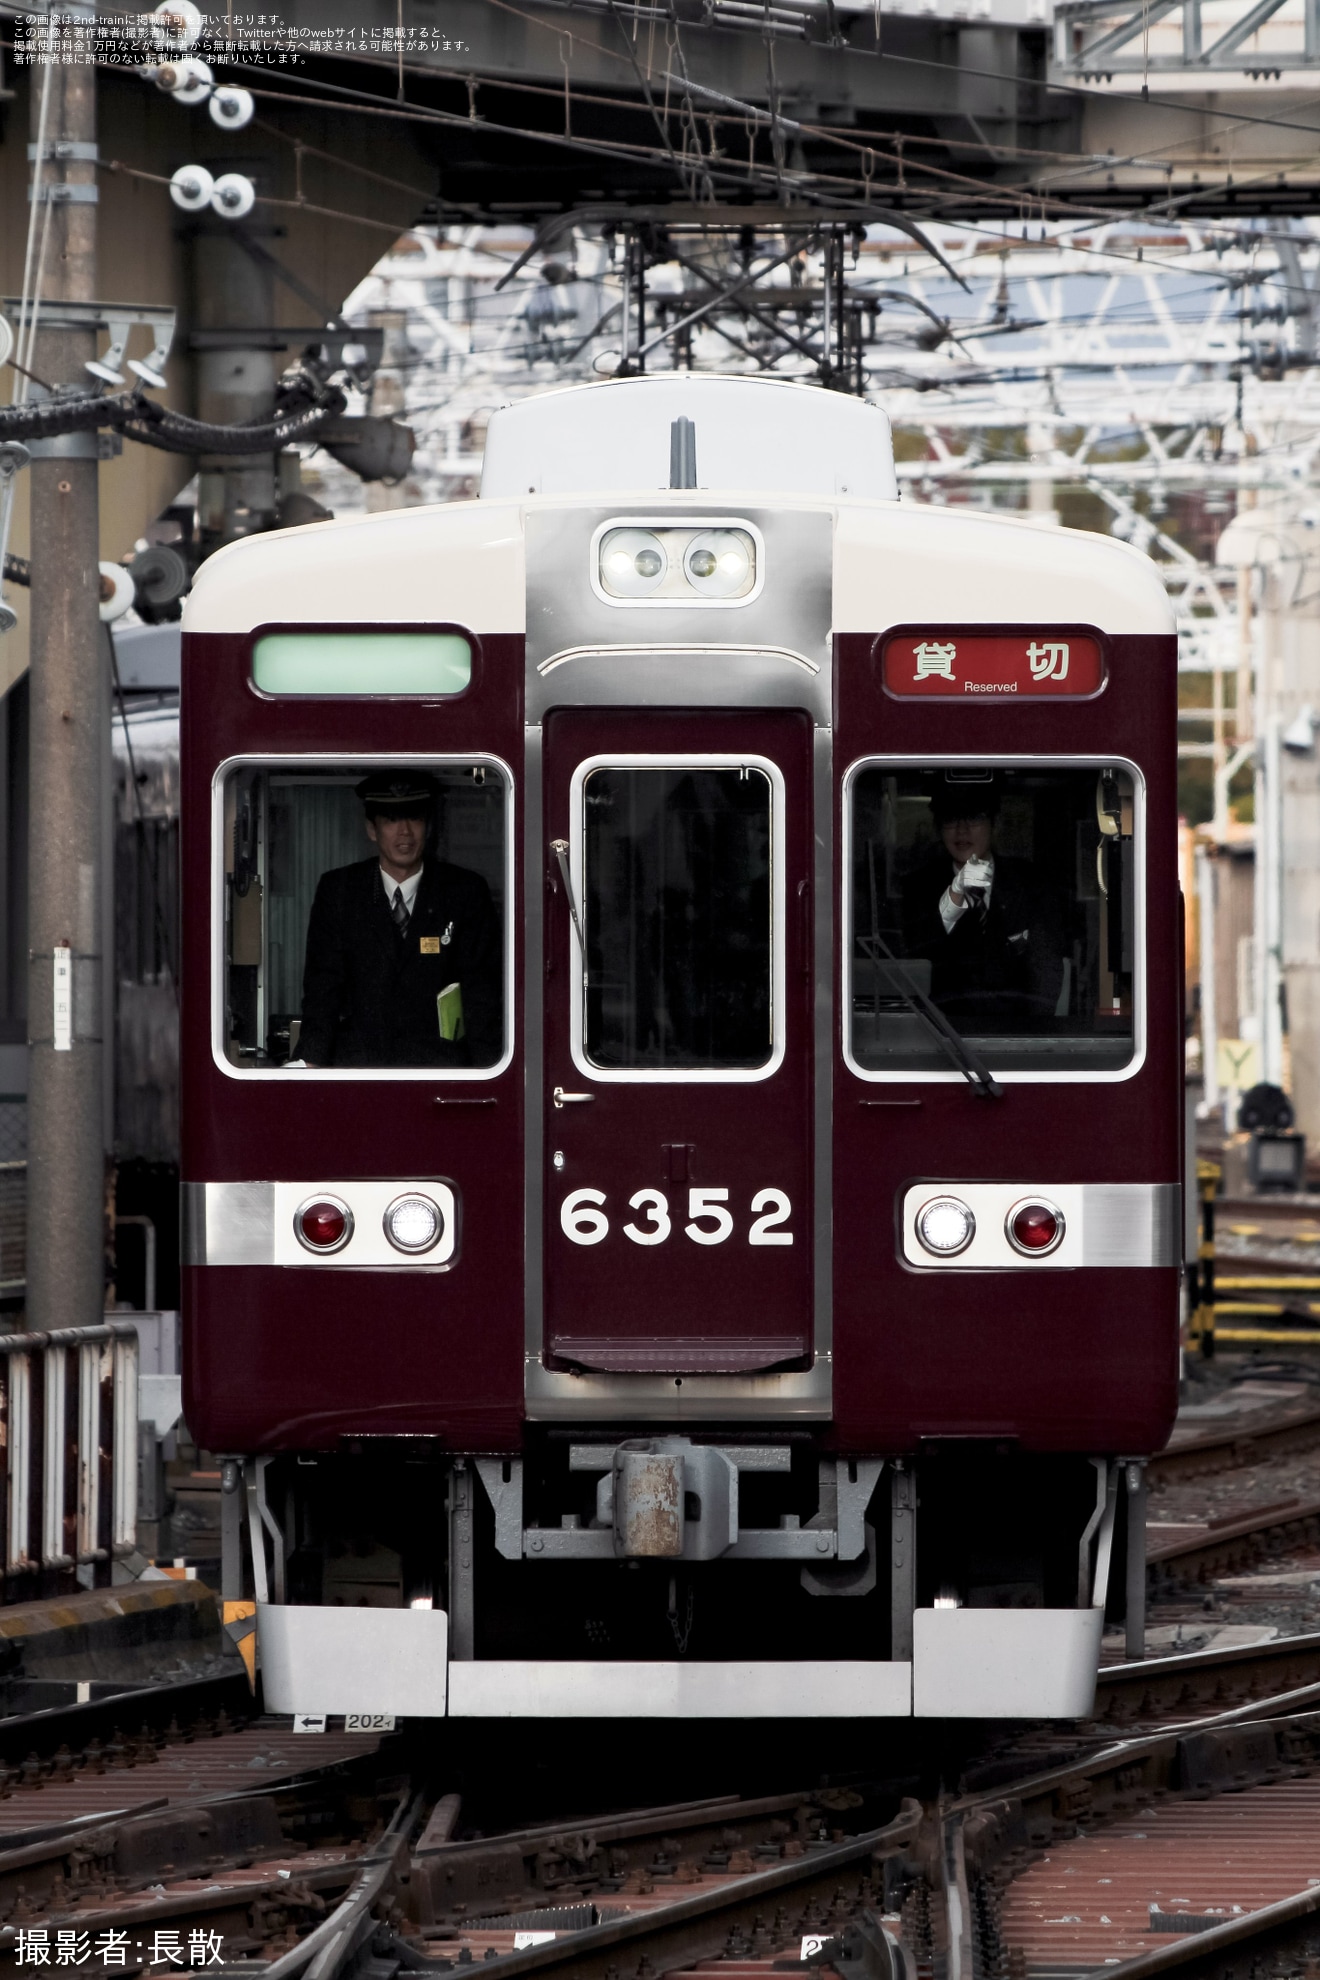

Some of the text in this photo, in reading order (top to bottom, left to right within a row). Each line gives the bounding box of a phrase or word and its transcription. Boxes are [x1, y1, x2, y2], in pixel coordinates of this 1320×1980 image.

[964, 681, 1018, 692] Reserved
[1224, 1046, 1253, 1080] Y
[560, 1187, 794, 1247] 6352
